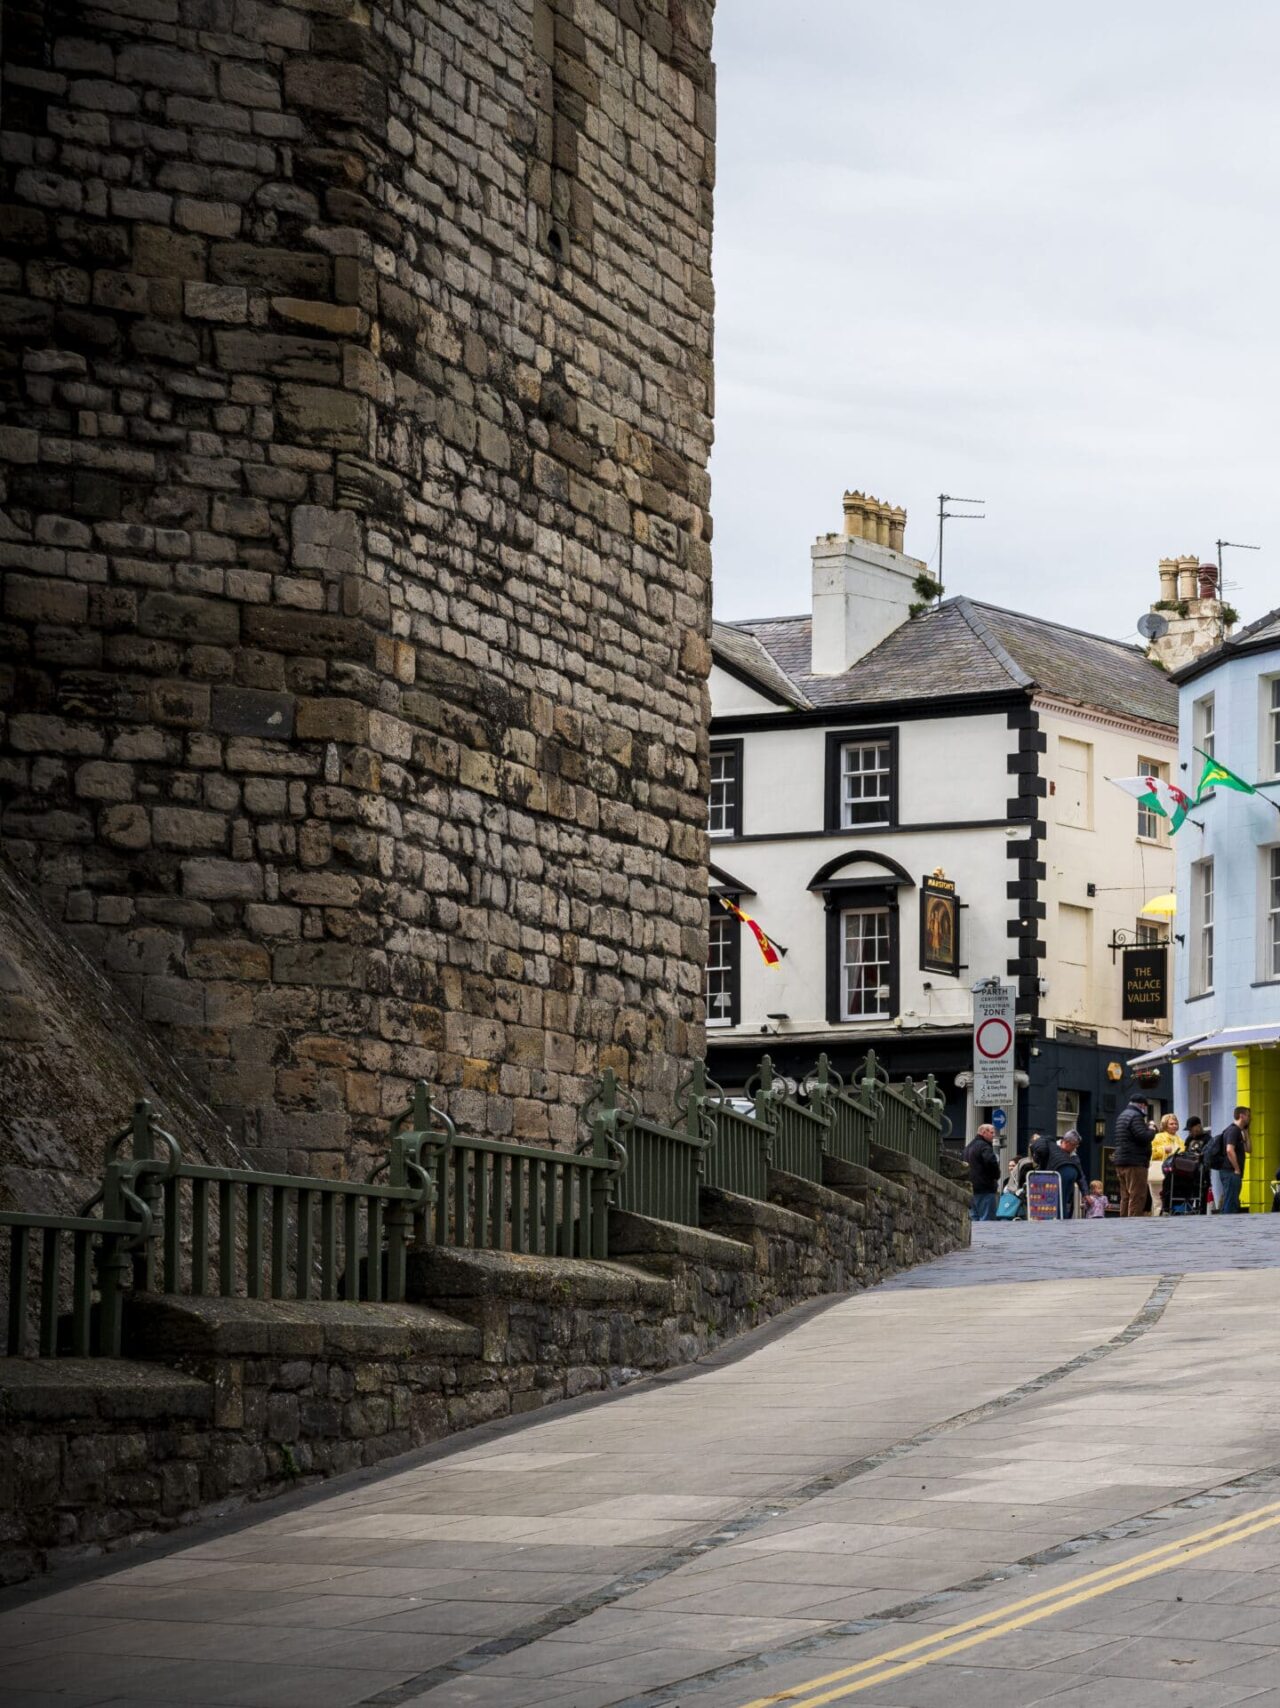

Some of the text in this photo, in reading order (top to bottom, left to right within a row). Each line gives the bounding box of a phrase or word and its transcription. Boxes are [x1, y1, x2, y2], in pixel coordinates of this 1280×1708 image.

[1134, 967, 1152, 977] THE
[1127, 979, 1161, 990] PALACE
[981, 988, 1008, 996] PARTH
[1128, 992, 1161, 1003] VAULTS
